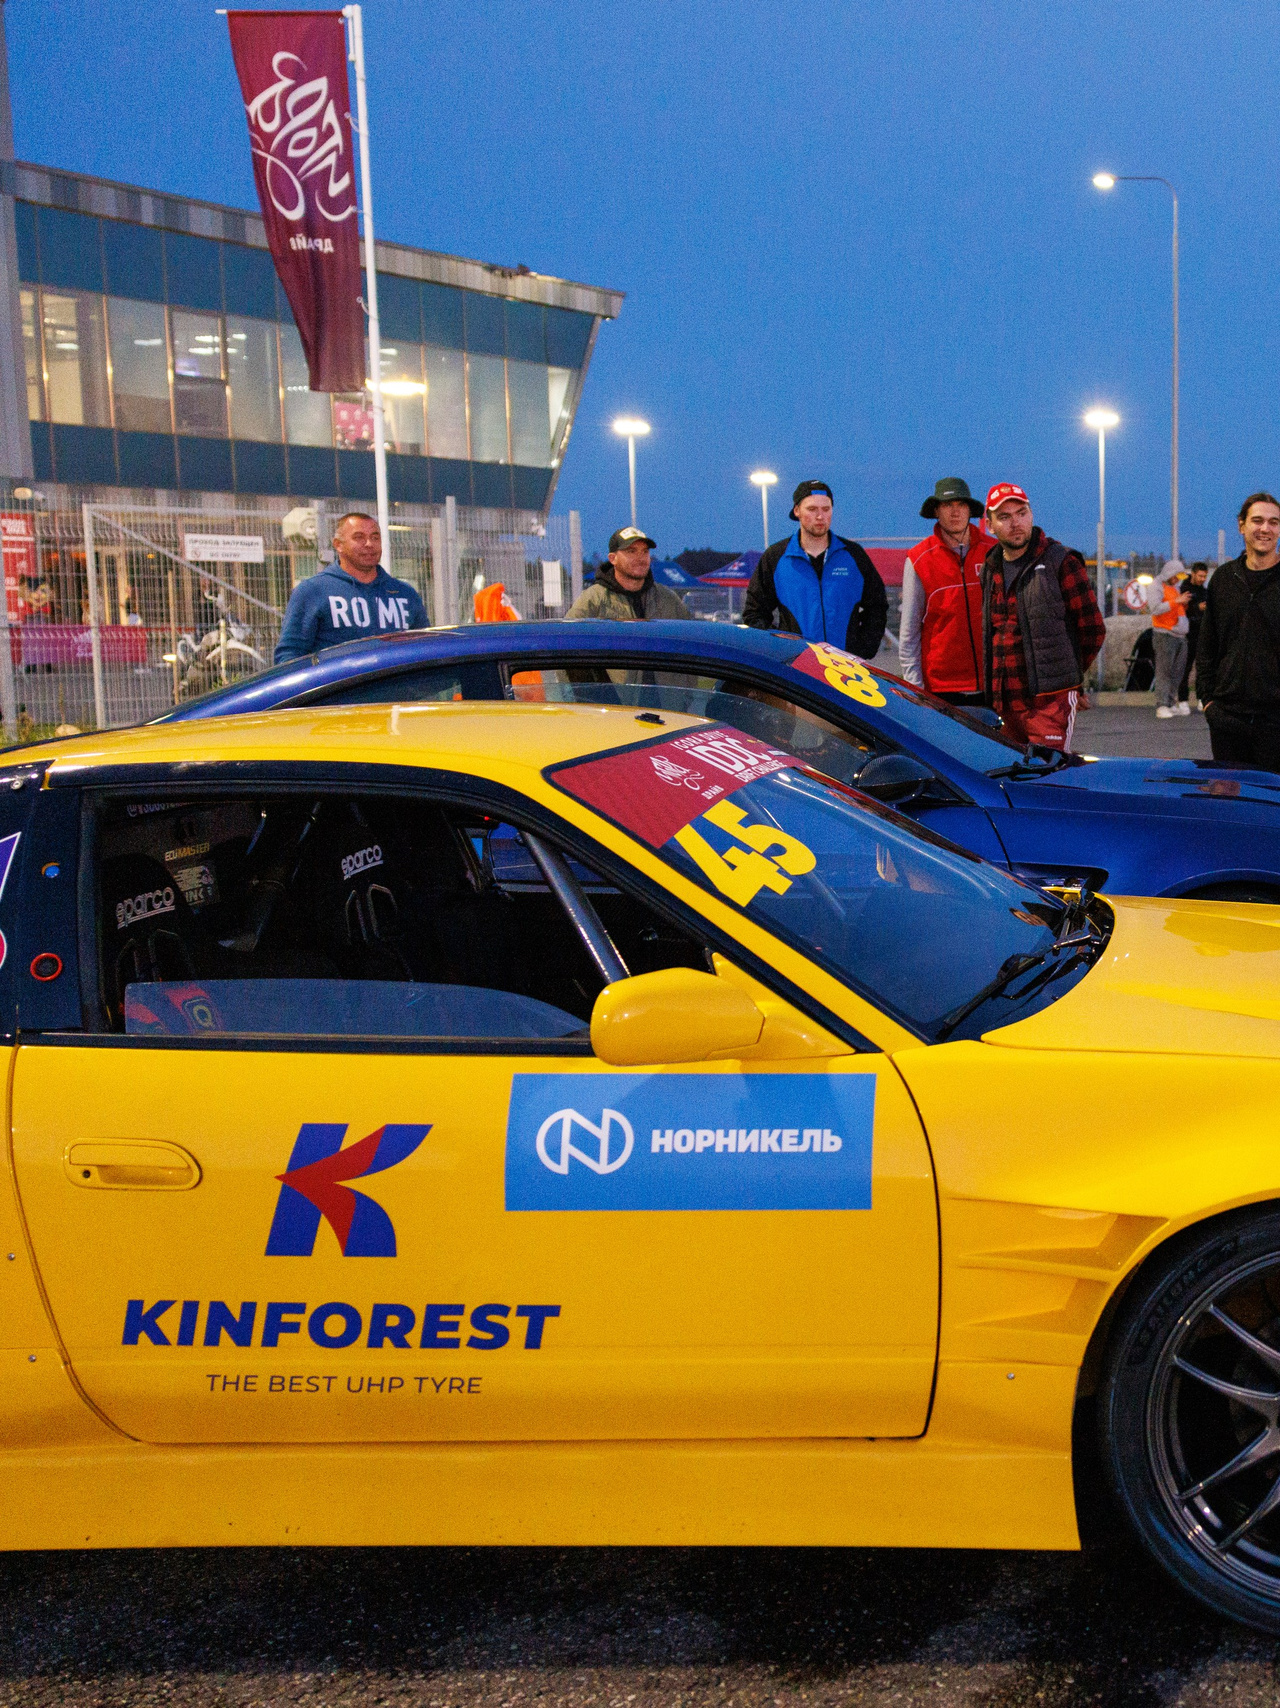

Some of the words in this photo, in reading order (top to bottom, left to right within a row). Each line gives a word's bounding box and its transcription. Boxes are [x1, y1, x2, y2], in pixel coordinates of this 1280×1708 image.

[669, 733, 703, 750] IGORA
[685, 737, 773, 776] IDDC
[341, 845, 384, 880] sparco
[674, 799, 817, 908] 45
[116, 887, 176, 929] sparco
[650, 1128, 843, 1153] НОРНИКЕЛЬ
[121, 1298, 562, 1350] KINFOREST
[206, 1373, 259, 1393] THE
[267, 1375, 338, 1394] BEST
[346, 1375, 404, 1394] UHP
[414, 1375, 483, 1395] TYRE
